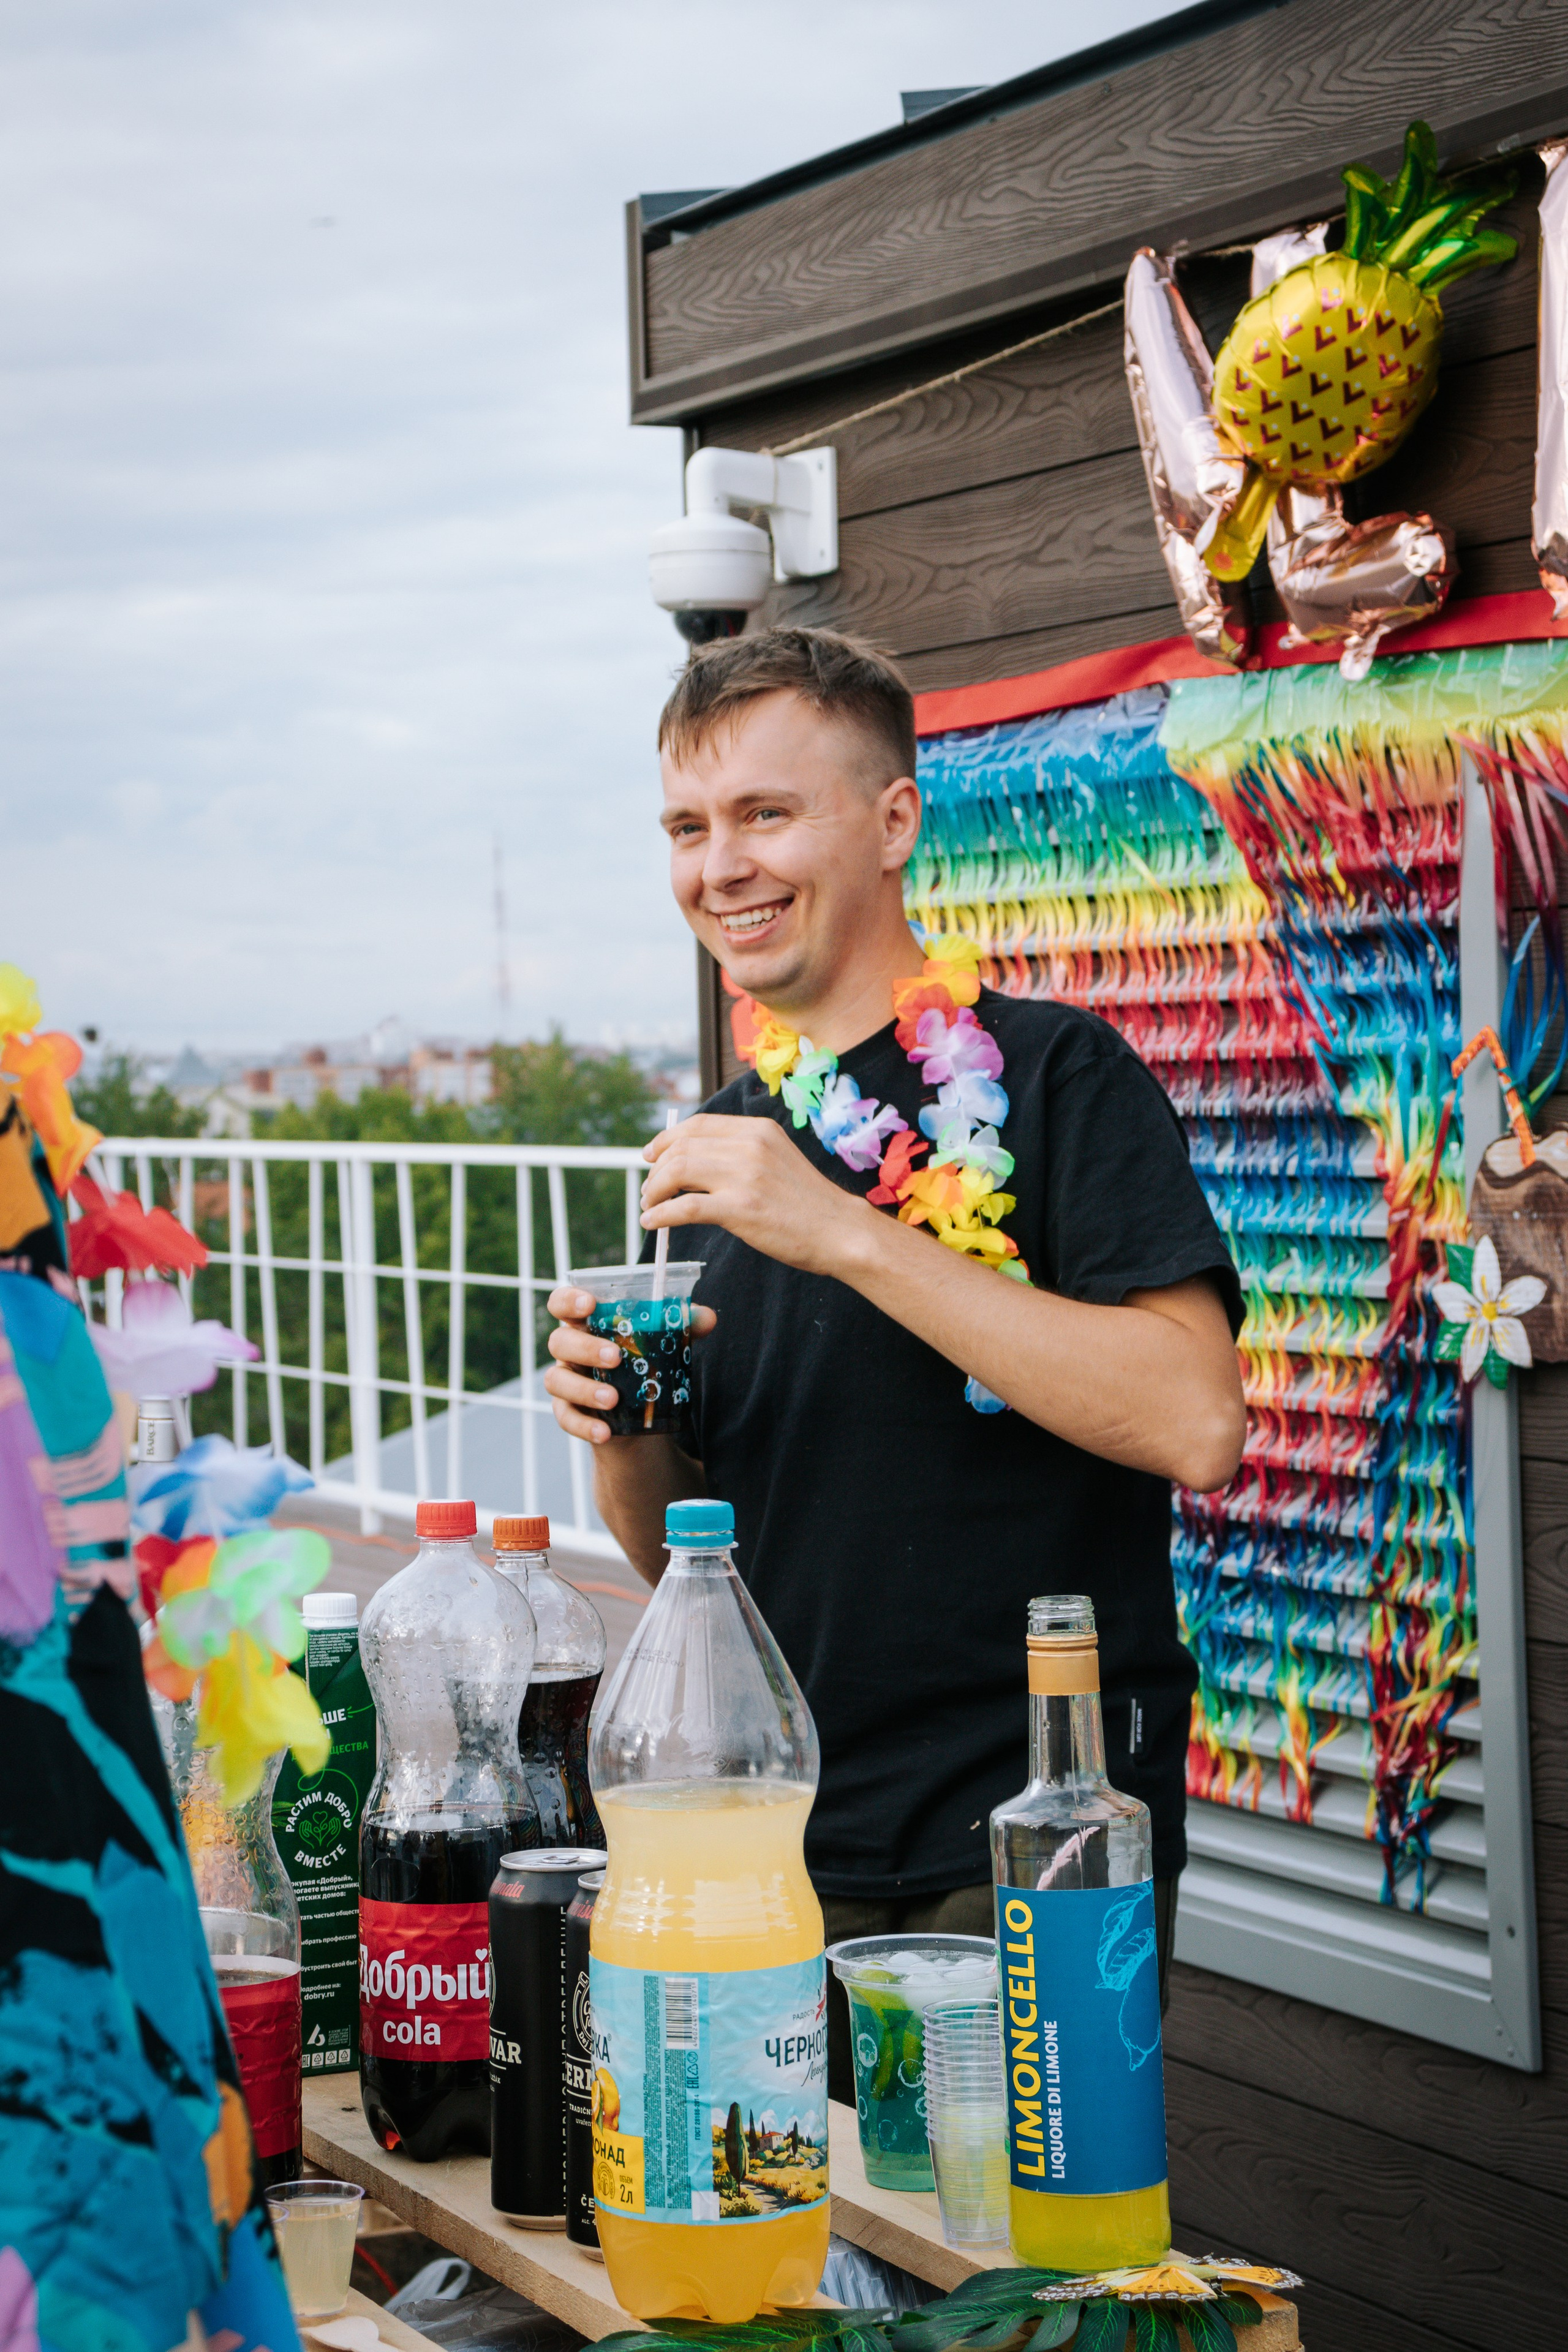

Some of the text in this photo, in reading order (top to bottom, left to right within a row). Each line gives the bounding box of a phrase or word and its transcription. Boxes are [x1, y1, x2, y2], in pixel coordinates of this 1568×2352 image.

[285, 1791, 352, 1832] РАСТИМ ДОБРО
[294, 1844, 347, 1869] ВМЕСТЕ
[323, 1934, 356, 1943] профессию
[360, 1943, 489, 2010] Добрый
[304, 1991, 335, 2000] dobry.ru
[793, 2008, 815, 2021] РАДОСТЬ
[383, 2015, 441, 2045] cola
[1005, 1899, 1046, 2177] LIMONCELLO
[1044, 2021, 1066, 2179] LIQUORE DI LIMONE
